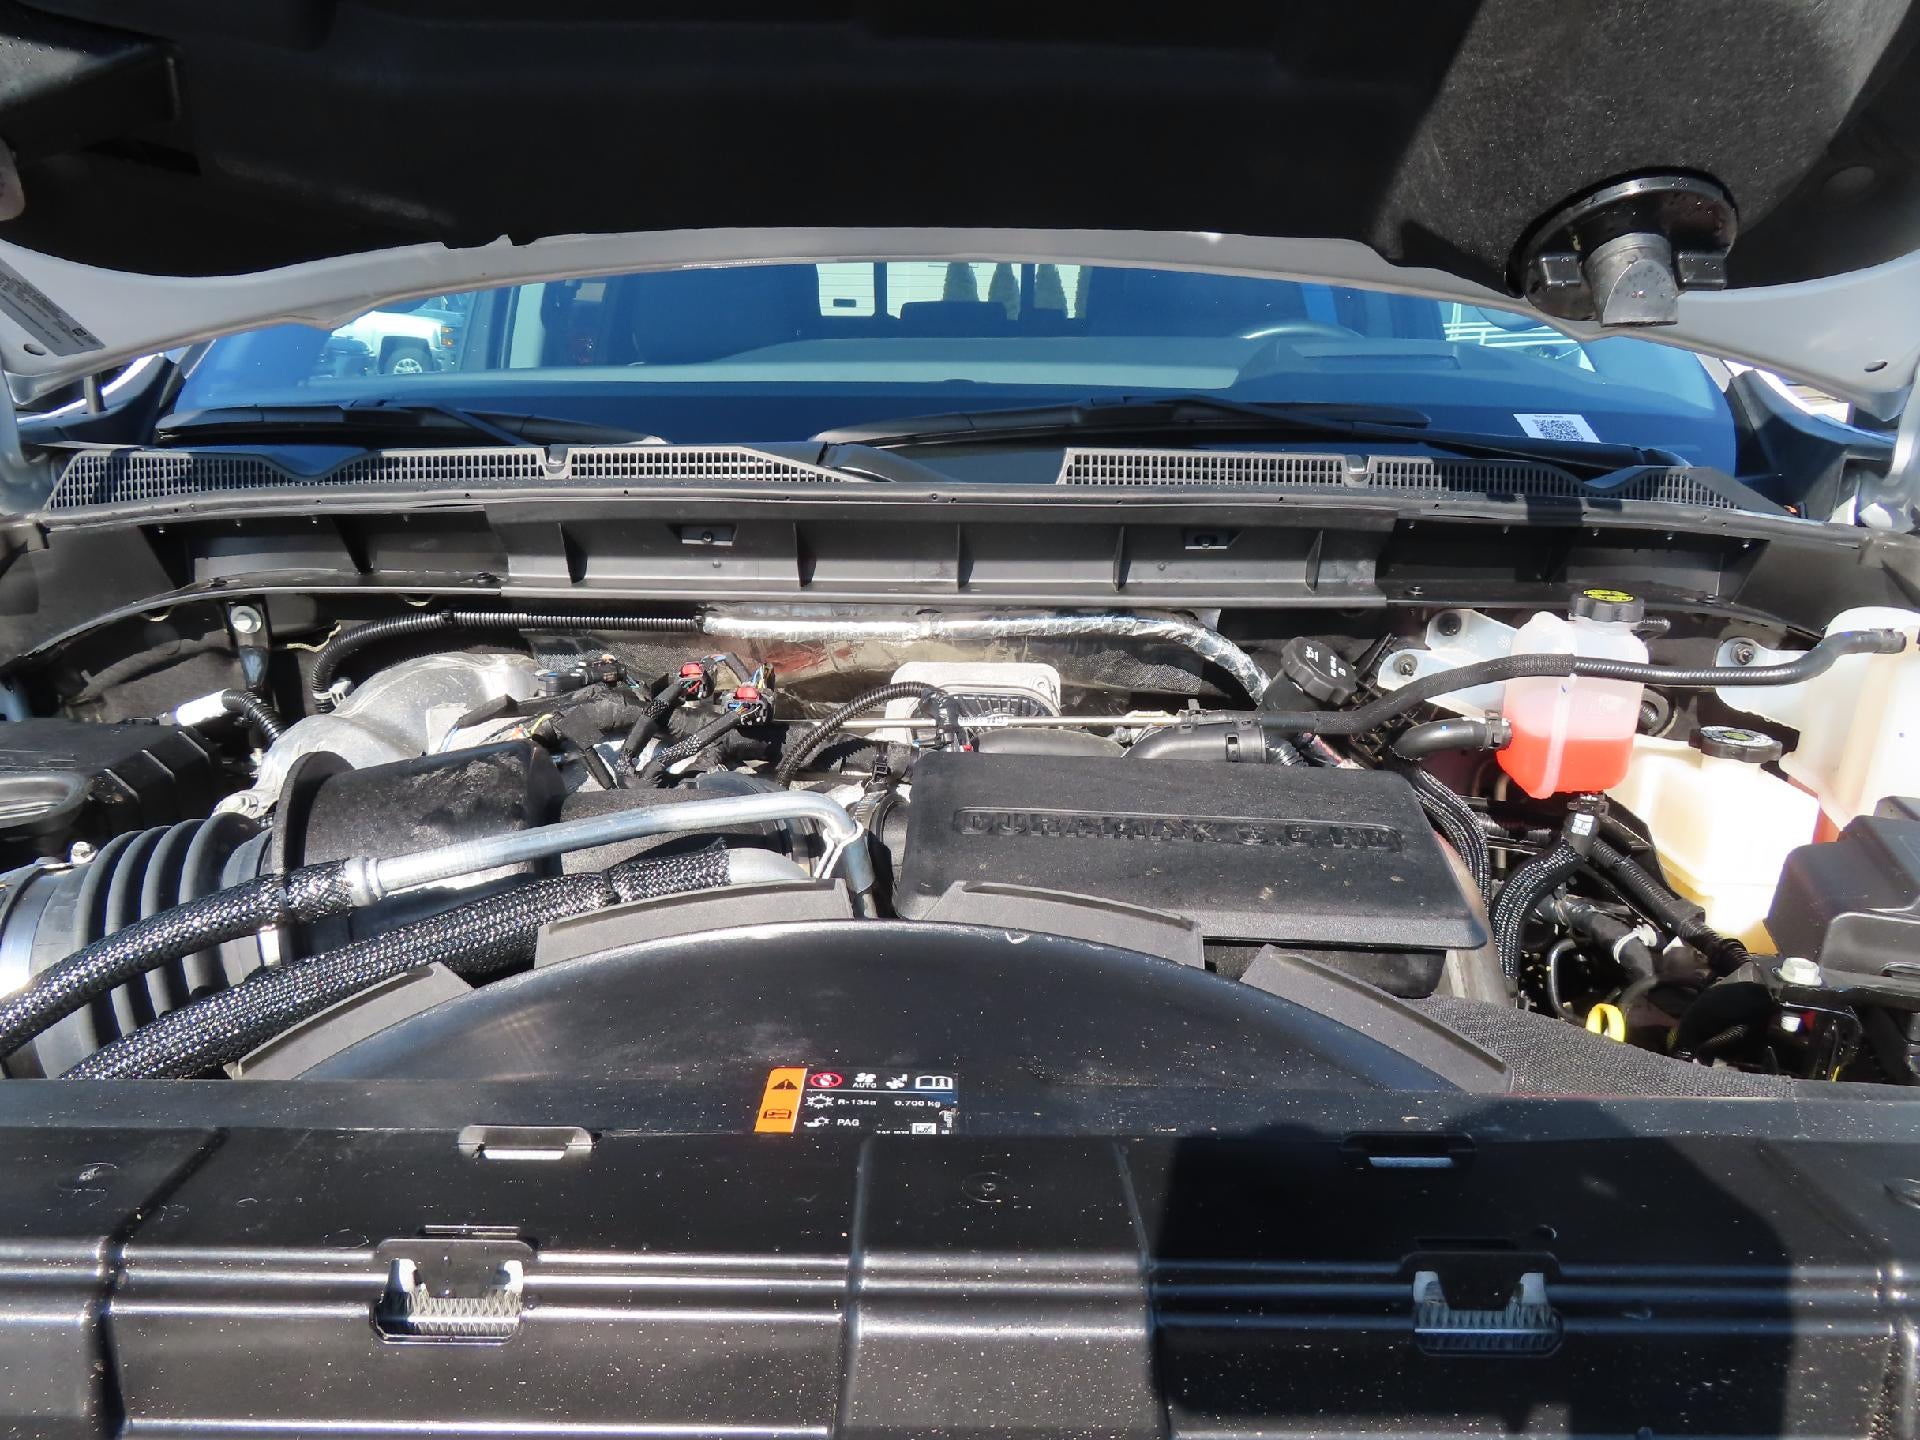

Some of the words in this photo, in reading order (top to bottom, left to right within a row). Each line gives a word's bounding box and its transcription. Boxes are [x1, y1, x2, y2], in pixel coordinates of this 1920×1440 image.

[837, 1098, 877, 1106] R-134a
[927, 1100, 941, 1109] kg
[836, 1118, 860, 1127] PAG
